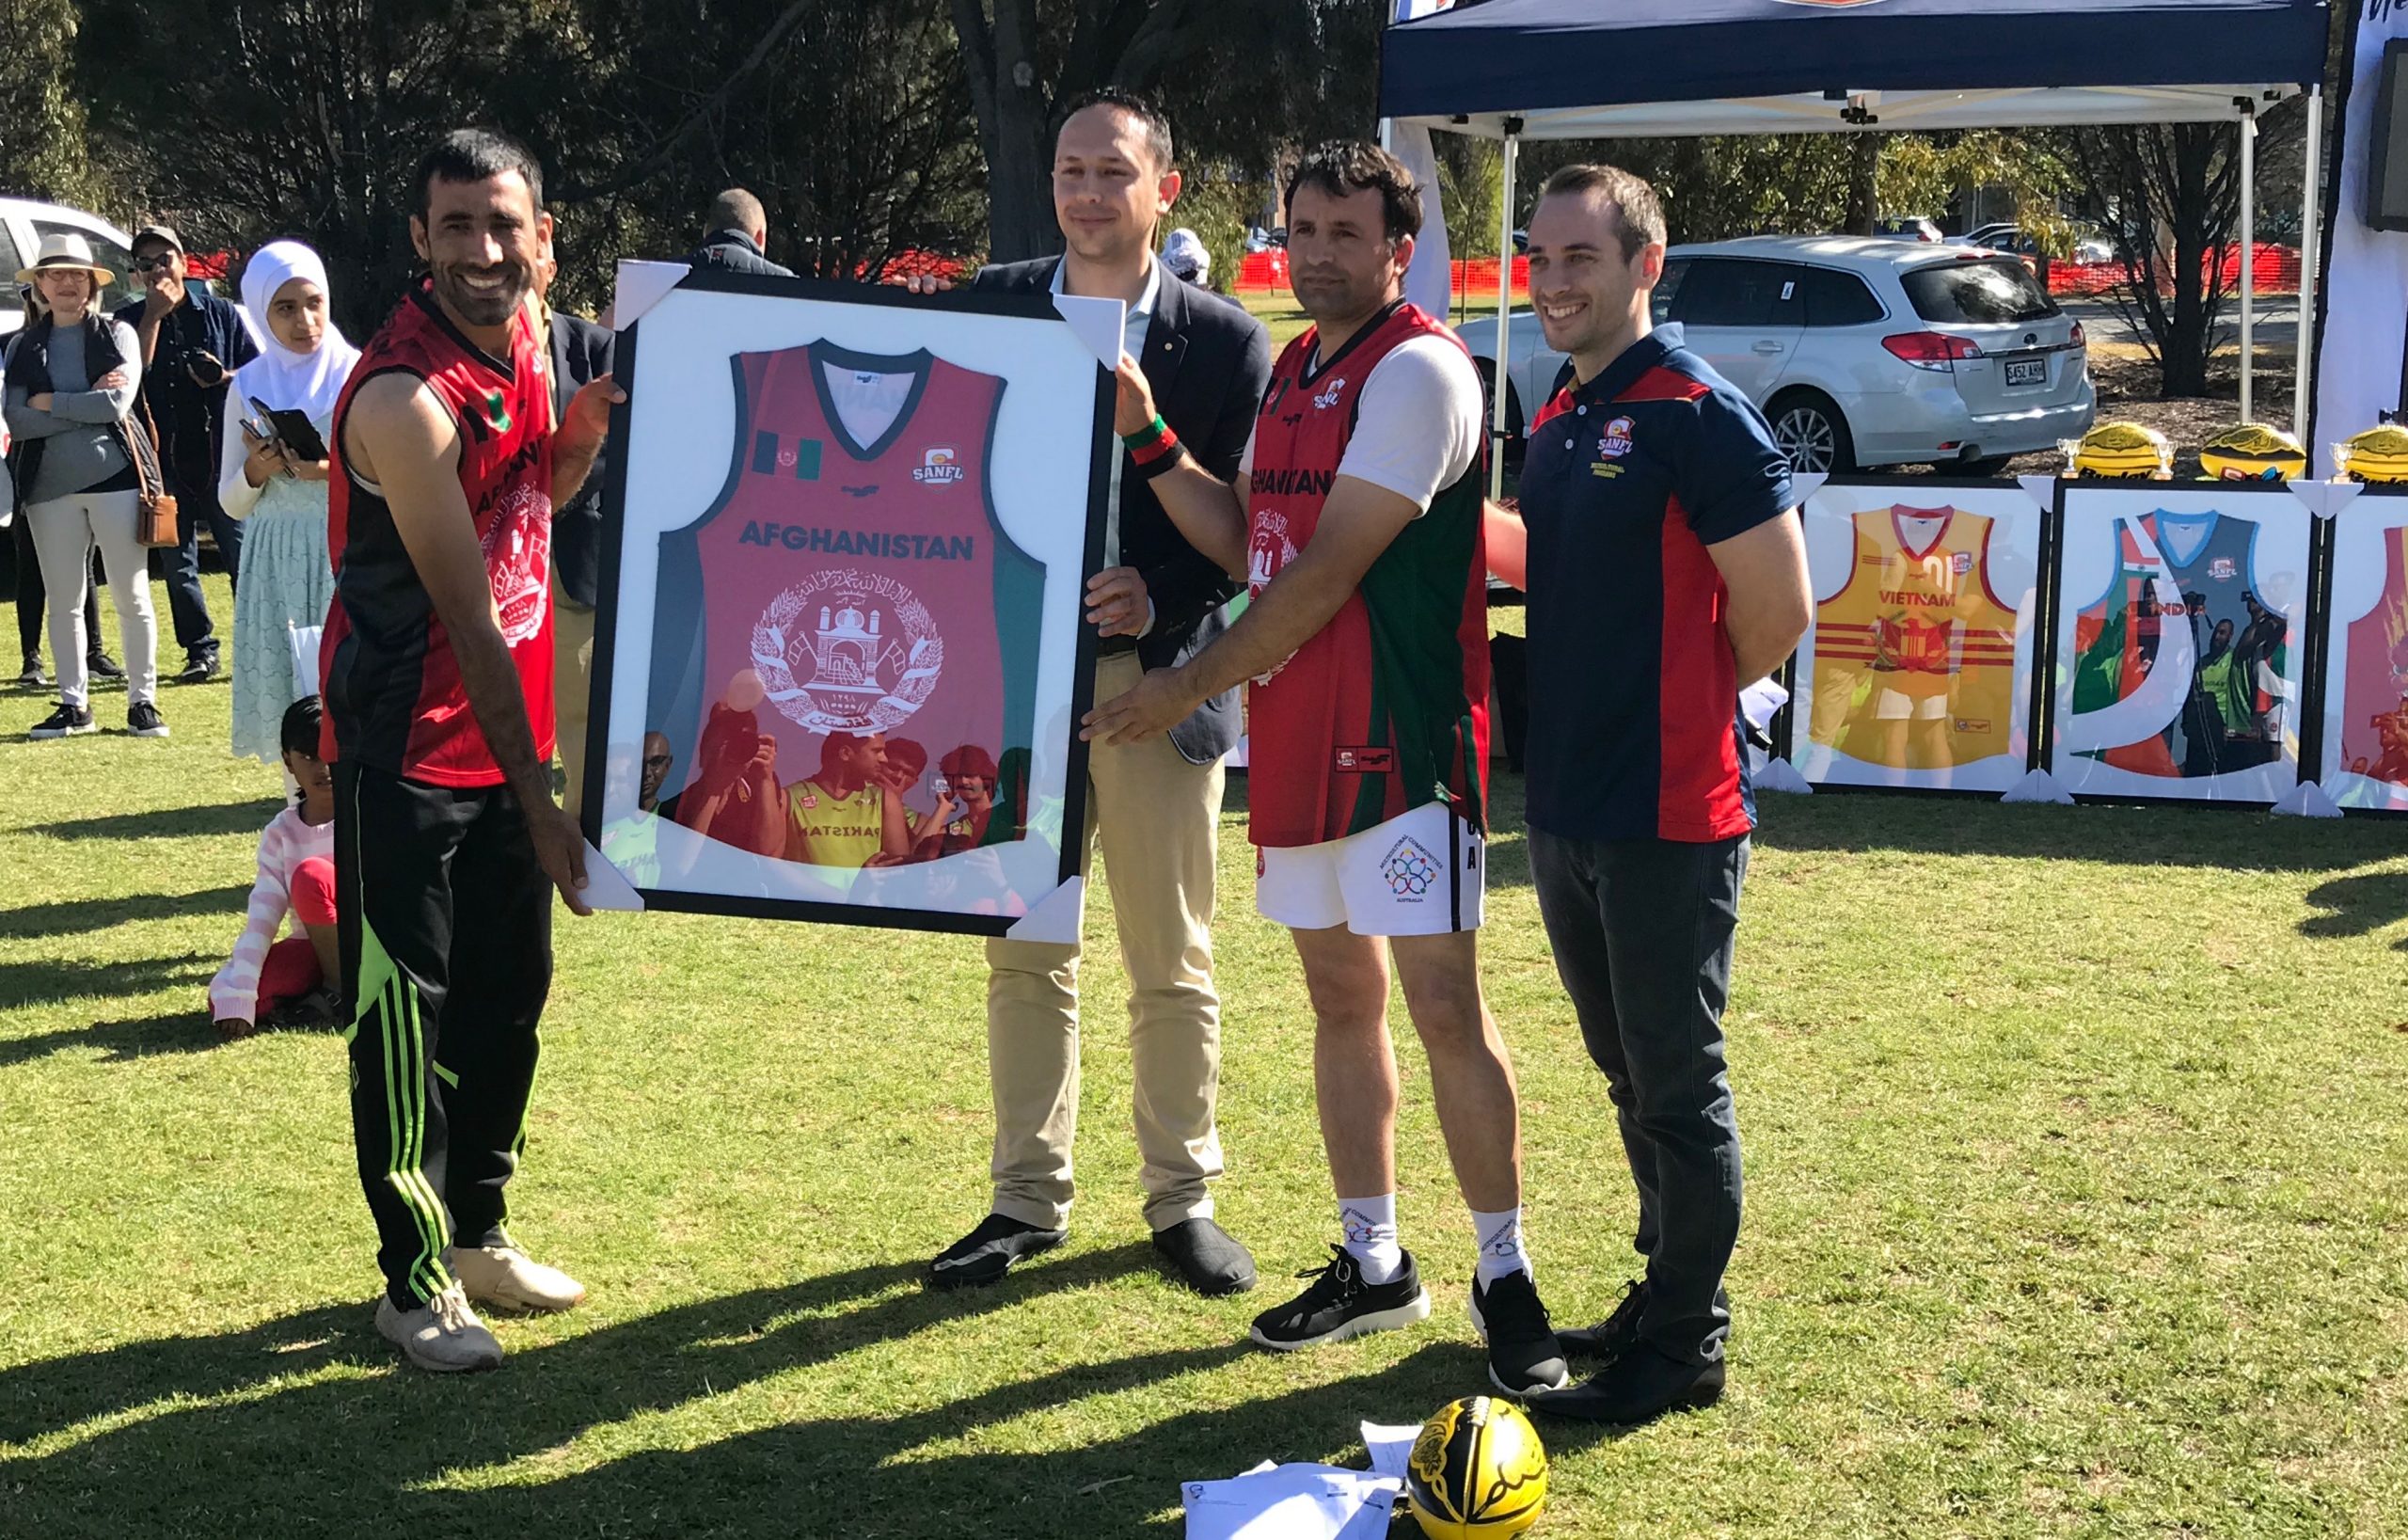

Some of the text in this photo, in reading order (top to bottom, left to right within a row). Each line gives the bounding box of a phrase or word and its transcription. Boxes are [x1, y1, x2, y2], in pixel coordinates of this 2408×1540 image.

[1597, 437, 1633, 453] SANFL
[912, 466, 964, 482] SANFL
[738, 520, 974, 562] AFGHANISTAN
[1878, 591, 1956, 608] VIETNAM
